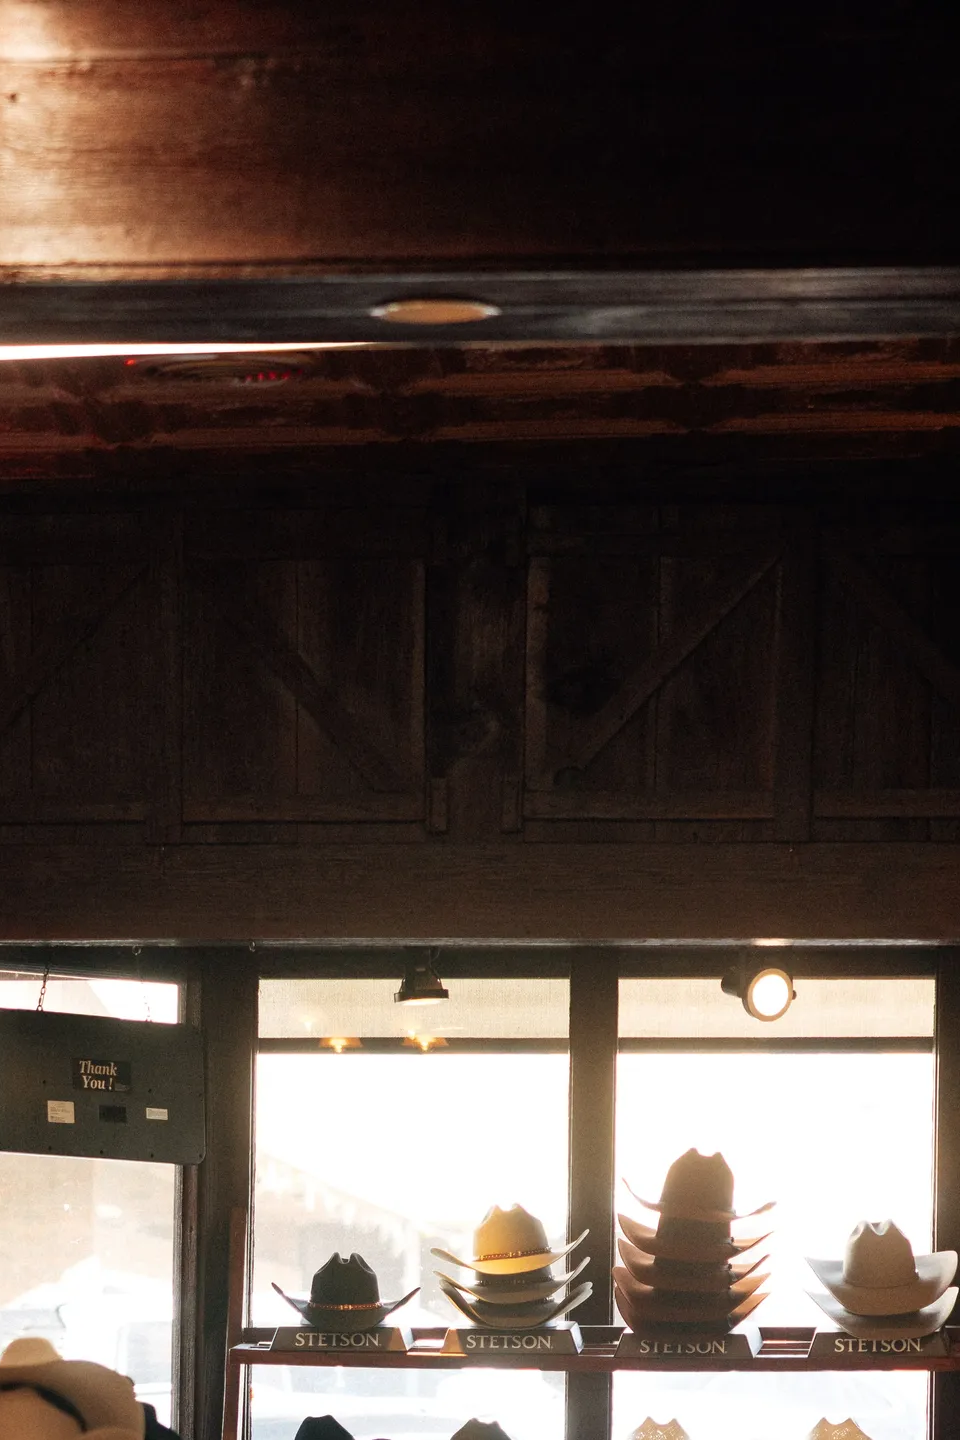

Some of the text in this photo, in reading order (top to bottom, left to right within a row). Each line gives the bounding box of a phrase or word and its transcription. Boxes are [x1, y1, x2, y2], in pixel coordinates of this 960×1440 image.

[79, 1060, 117, 1076] Thank
[295, 1332, 382, 1347] STETSON
[466, 1334, 554, 1349] STETSON
[834, 1338, 924, 1353] STETSON
